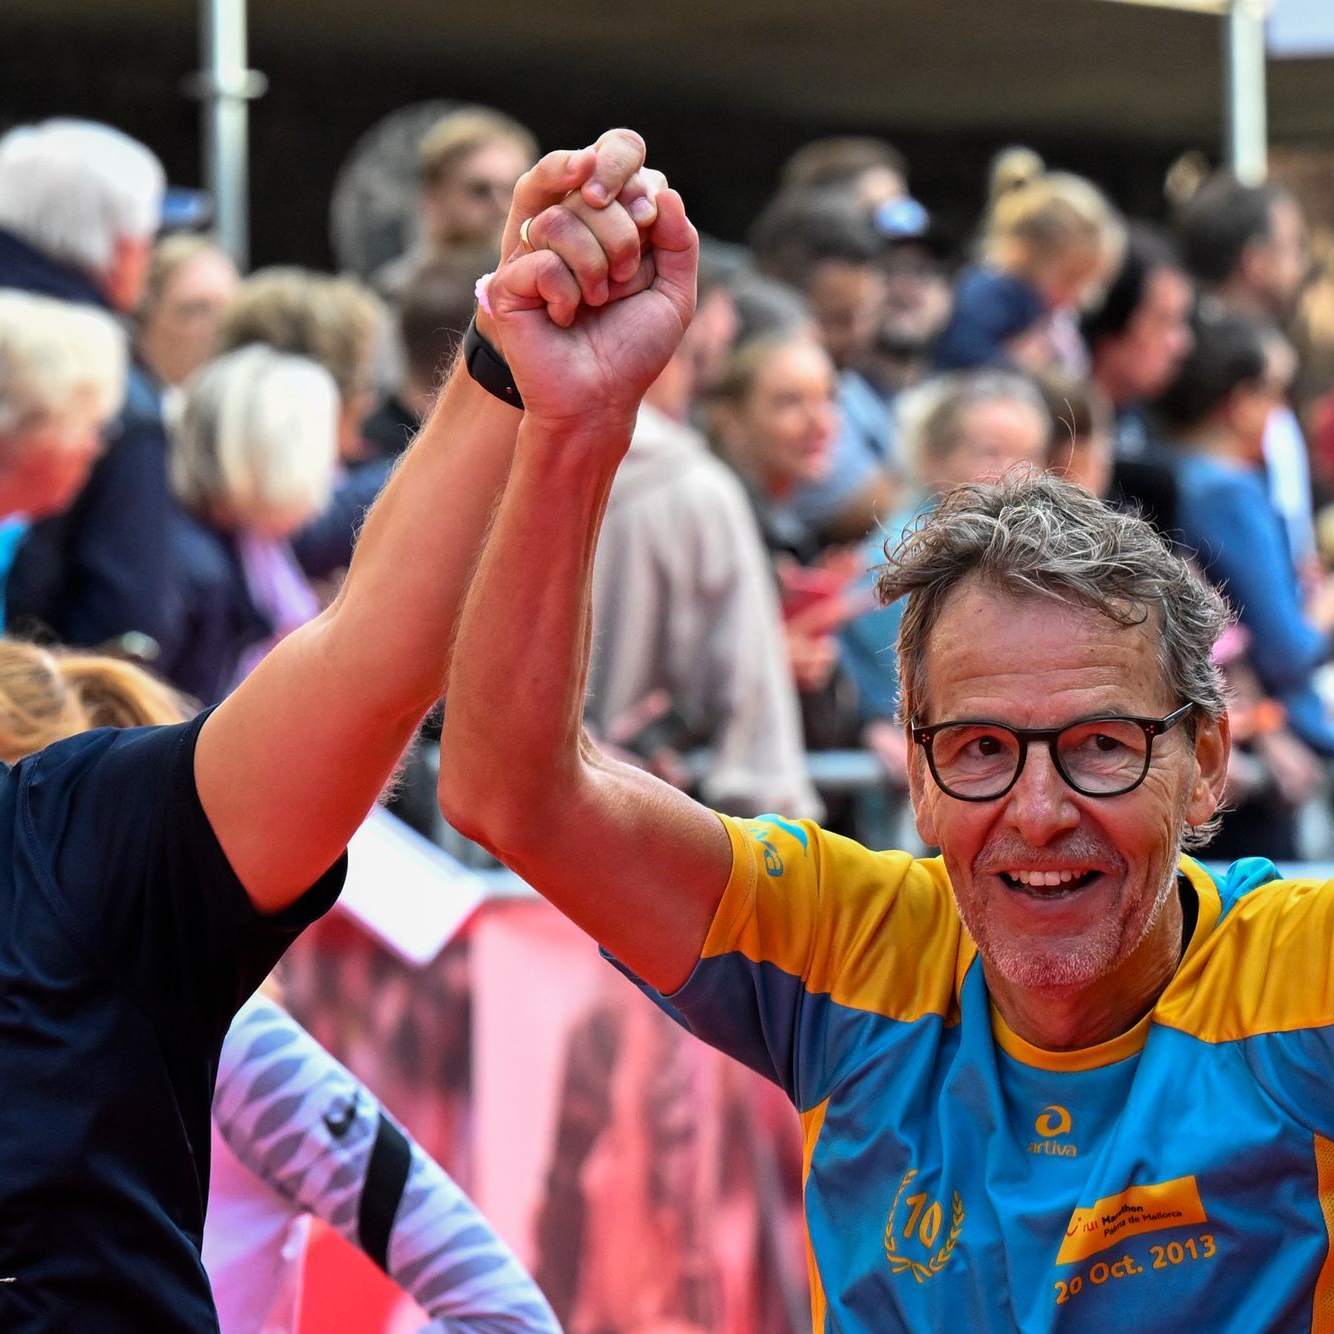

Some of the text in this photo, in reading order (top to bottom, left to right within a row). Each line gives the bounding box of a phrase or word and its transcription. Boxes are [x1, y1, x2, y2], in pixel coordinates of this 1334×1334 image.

[1128, 1215, 1140, 1223] de
[1054, 1234, 1216, 1304] 20 Oct. 2013
